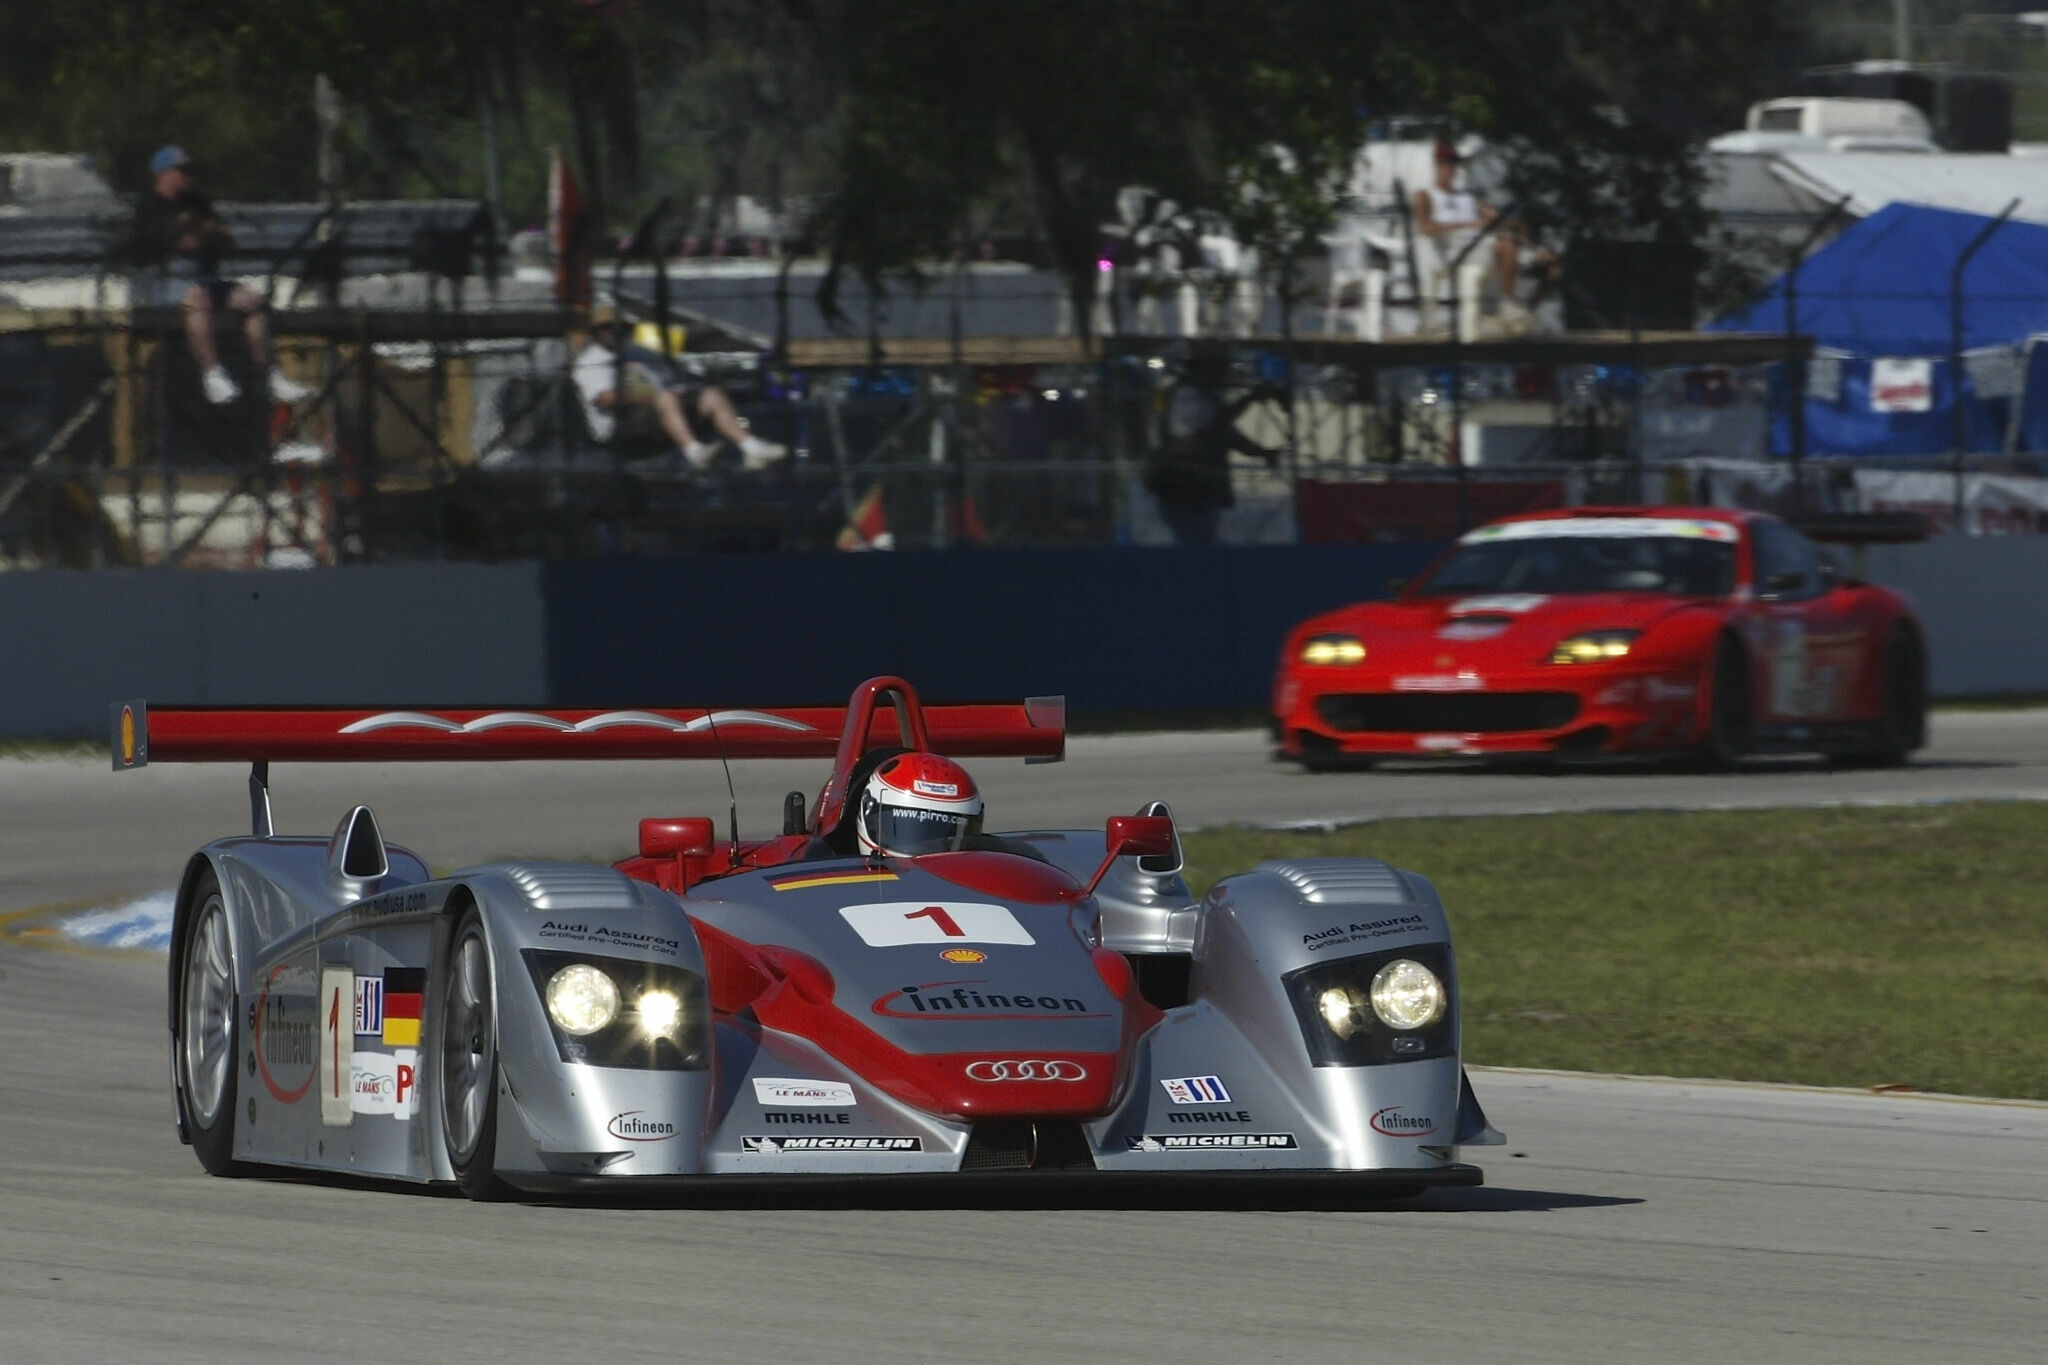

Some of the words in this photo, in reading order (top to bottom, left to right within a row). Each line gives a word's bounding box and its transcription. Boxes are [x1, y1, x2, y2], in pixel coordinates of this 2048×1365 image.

[903, 906, 966, 937] 1
[1303, 926, 1344, 944] Audi
[1349, 914, 1423, 932] Assured
[539, 930, 585, 941] Certified
[587, 935, 649, 950] Pre-Owned
[652, 945, 677, 956] Cars
[541, 921, 589, 933] Audi
[595, 927, 680, 948] Assured
[1307, 936, 1349, 951] Certified
[1350, 927, 1406, 941] Pre-Owned
[1406, 924, 1429, 933] Cars
[328, 986, 340, 1098] 1
[362, 1080, 381, 1095] MANS
[793, 1090, 827, 1098] MANS
[765, 1112, 851, 1125] MAHLE
[1167, 1111, 1252, 1123] MAHLE
[783, 1138, 914, 1149] MICHELIN
[1165, 1136, 1288, 1146] MICHELIN
